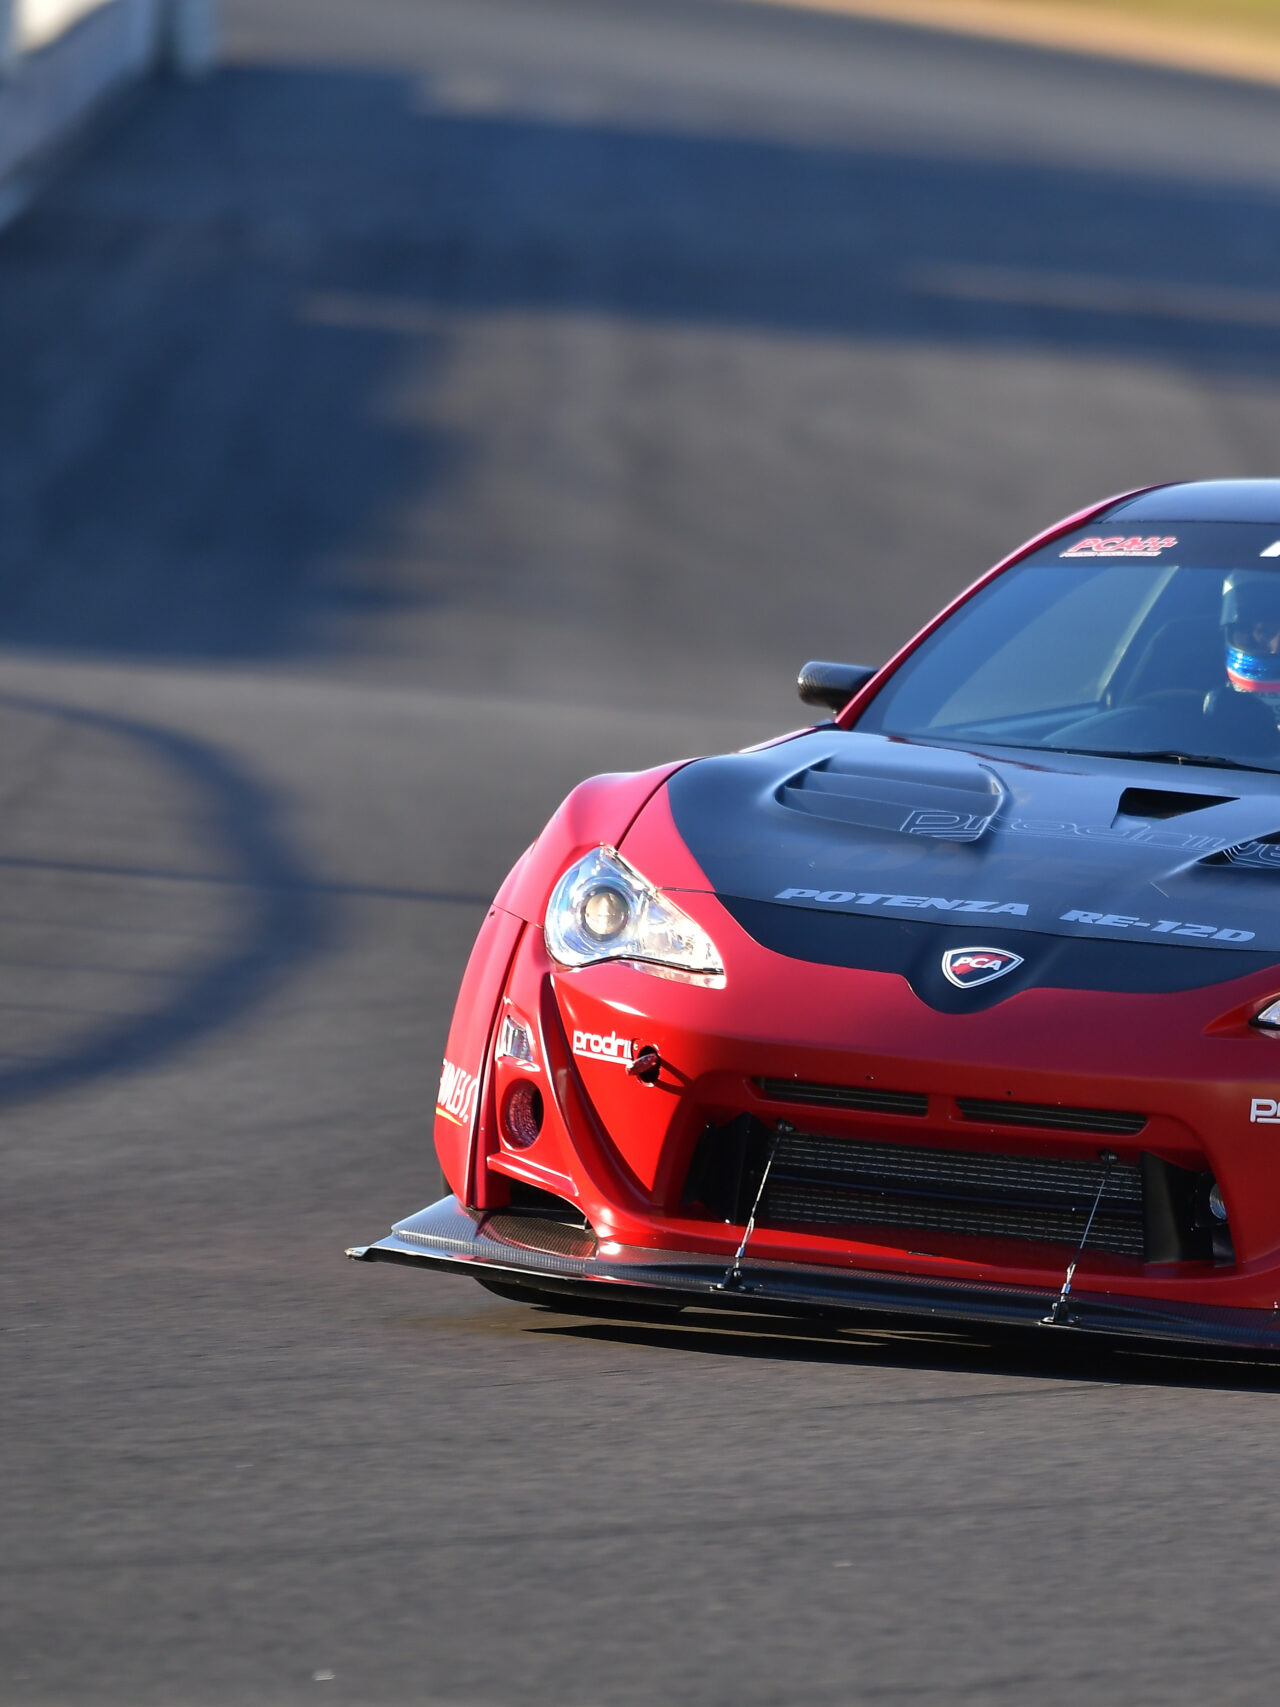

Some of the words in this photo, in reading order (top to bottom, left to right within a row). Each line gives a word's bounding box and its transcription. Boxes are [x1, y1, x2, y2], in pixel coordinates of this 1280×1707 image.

[774, 888, 1030, 916] POTENZA
[1059, 909, 1256, 942] RE-12D
[952, 956, 1003, 971] PCA
